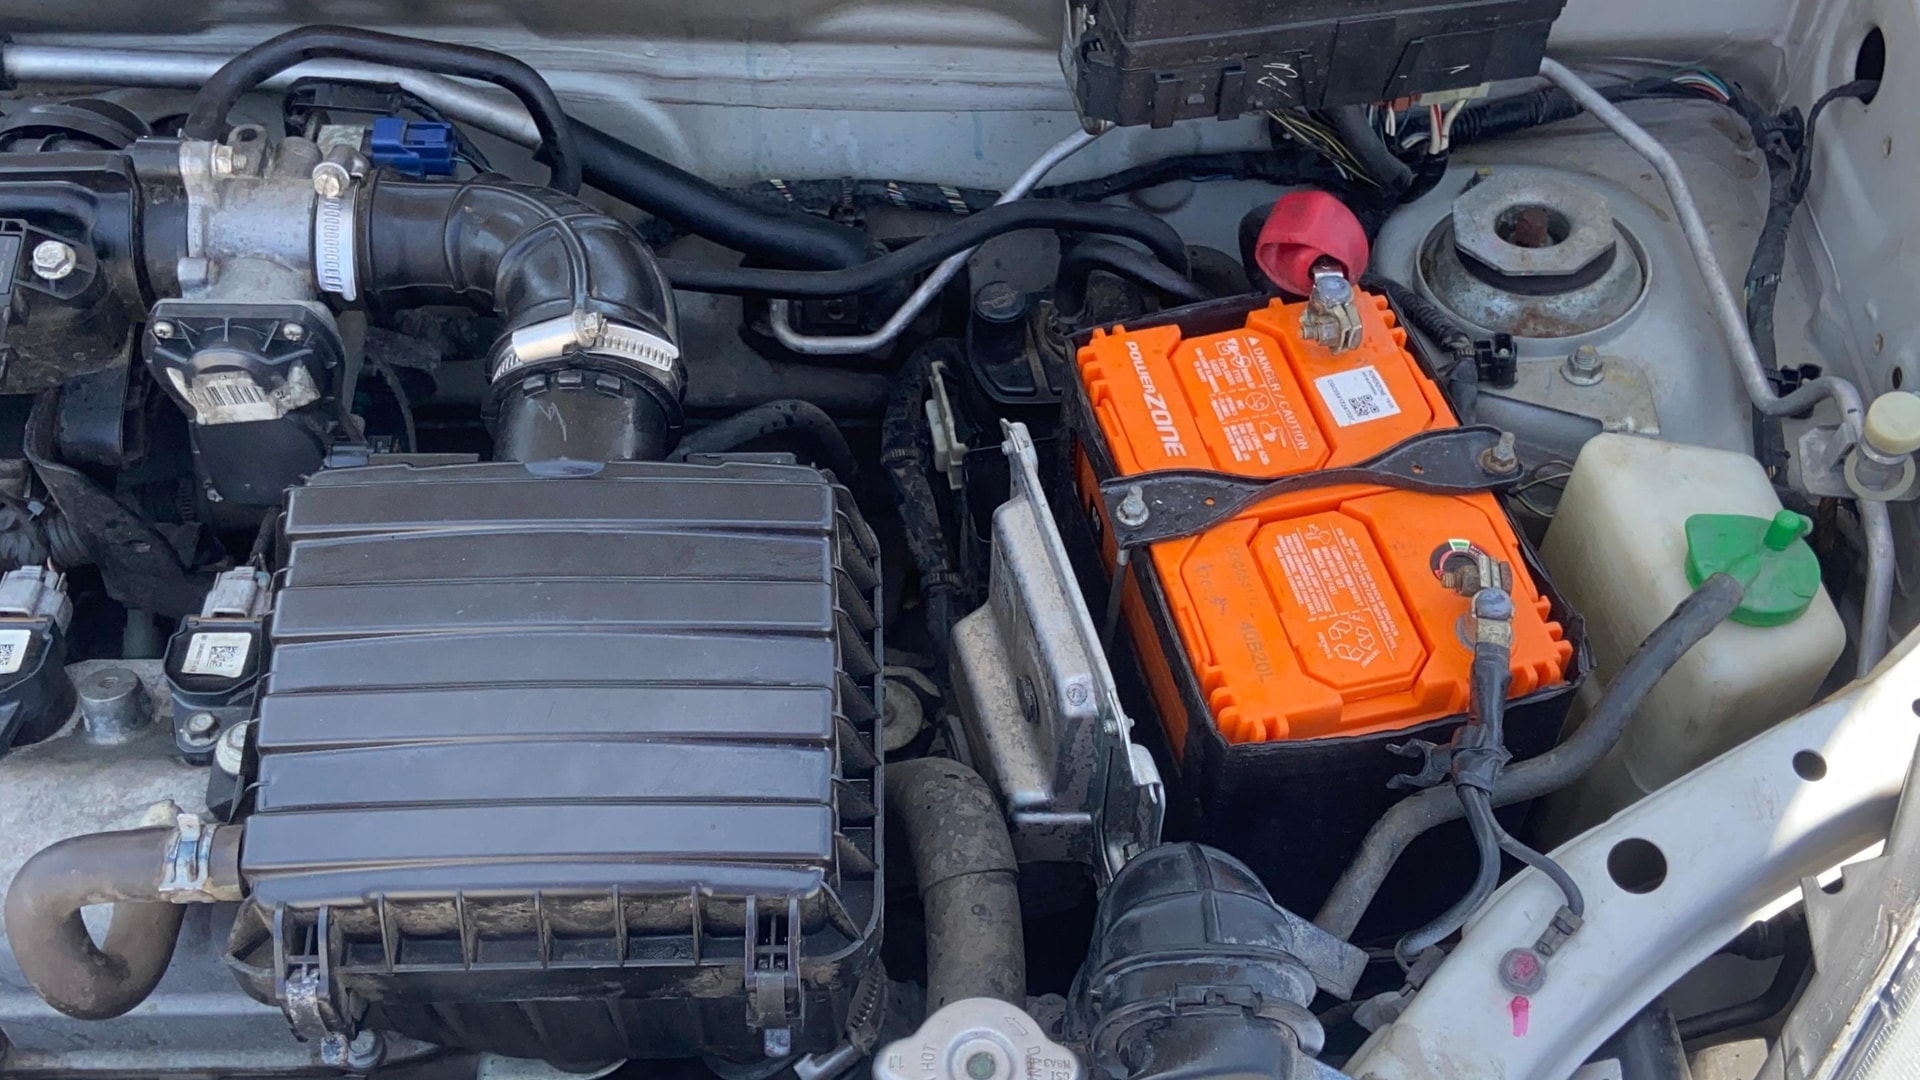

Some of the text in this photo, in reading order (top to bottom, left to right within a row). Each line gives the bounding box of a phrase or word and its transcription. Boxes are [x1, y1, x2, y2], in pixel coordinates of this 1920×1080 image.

[1252, 344, 1281, 392] DANGER
[1278, 398, 1309, 452] CAUTION
[1238, 619, 1274, 683] 40B20L
[920, 1042, 937, 1071] HOT
